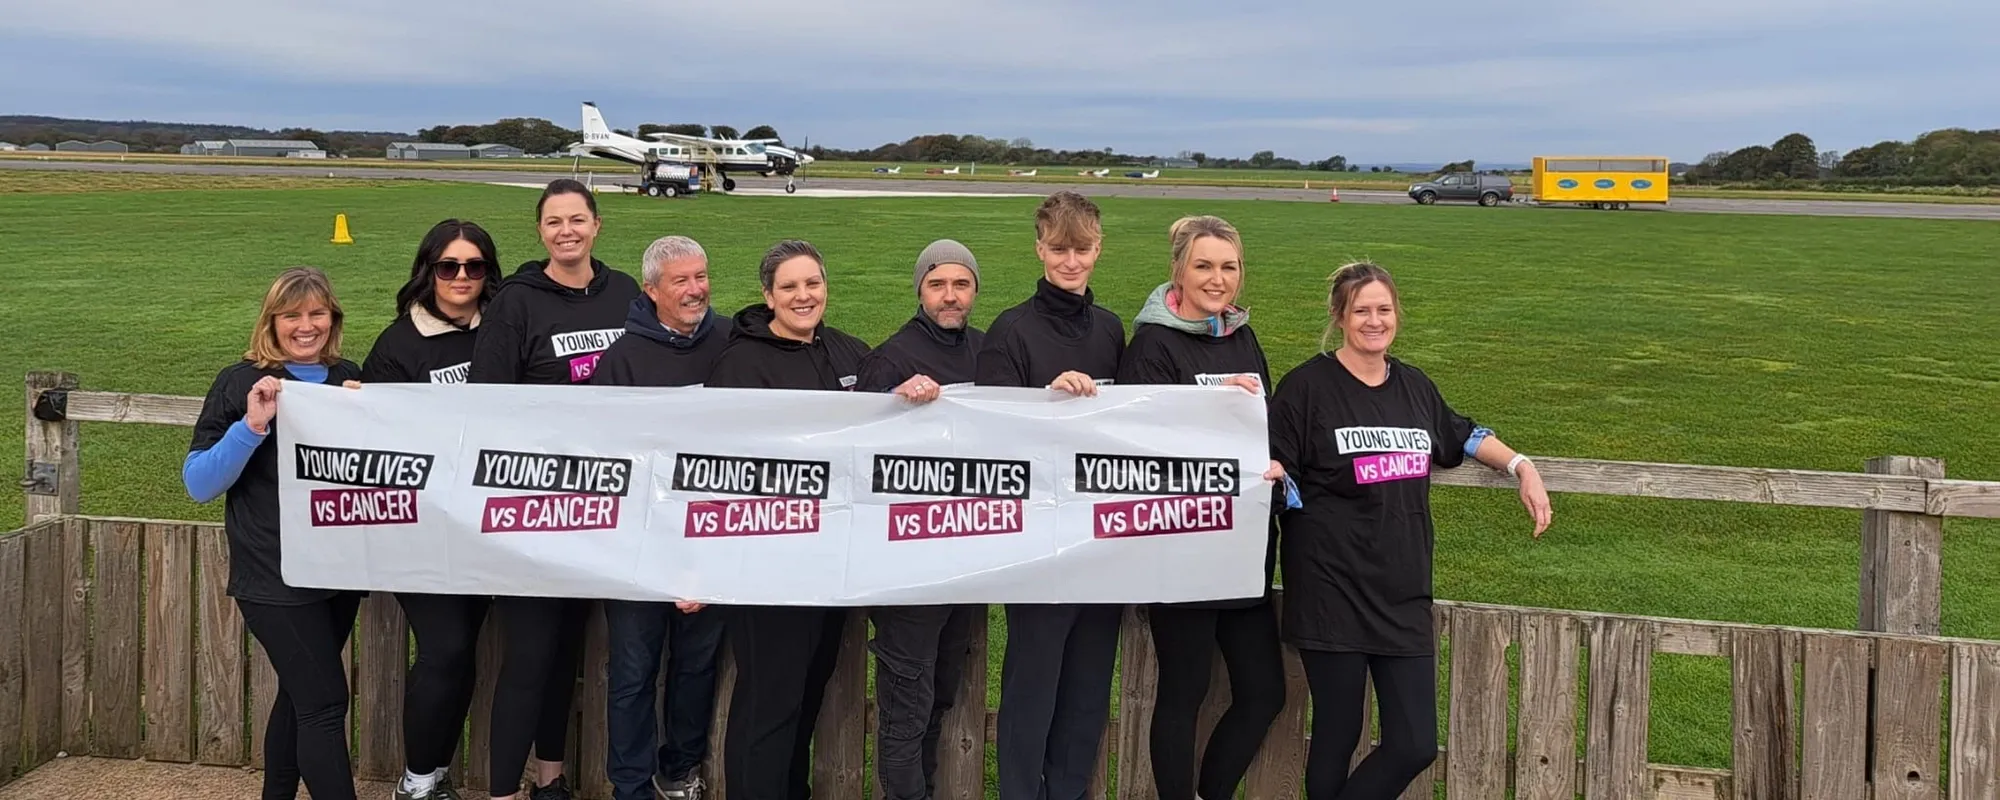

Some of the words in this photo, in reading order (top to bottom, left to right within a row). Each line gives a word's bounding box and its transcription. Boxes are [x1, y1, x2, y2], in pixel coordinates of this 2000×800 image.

[557, 332, 604, 352] YOUNG
[434, 365, 470, 384] YOUN
[1341, 430, 1391, 450] YOUNG
[1392, 430, 1429, 450] LIVES
[299, 448, 359, 483] YOUNG
[363, 454, 427, 487] LIVES
[483, 453, 558, 487] YOUNG
[562, 460, 626, 492] LIVES
[682, 457, 756, 492] YOUNG
[761, 461, 824, 495] LIVES
[880, 458, 955, 492] YOUNG
[961, 461, 1025, 496] LIVES
[1081, 458, 1161, 491] YOUNG
[1167, 461, 1235, 493] LIVES
[1359, 464, 1378, 479] vs
[1380, 454, 1427, 477] CANCER
[315, 499, 336, 522] vs
[339, 490, 412, 521] CANCER
[490, 506, 517, 528] vs
[522, 497, 613, 527] CANCER
[692, 511, 718, 533] vs
[725, 500, 814, 532] CANCER
[895, 513, 921, 536] vs
[927, 499, 1018, 535] CANCER
[1100, 511, 1127, 532] vs
[1133, 497, 1227, 531] CANCER
